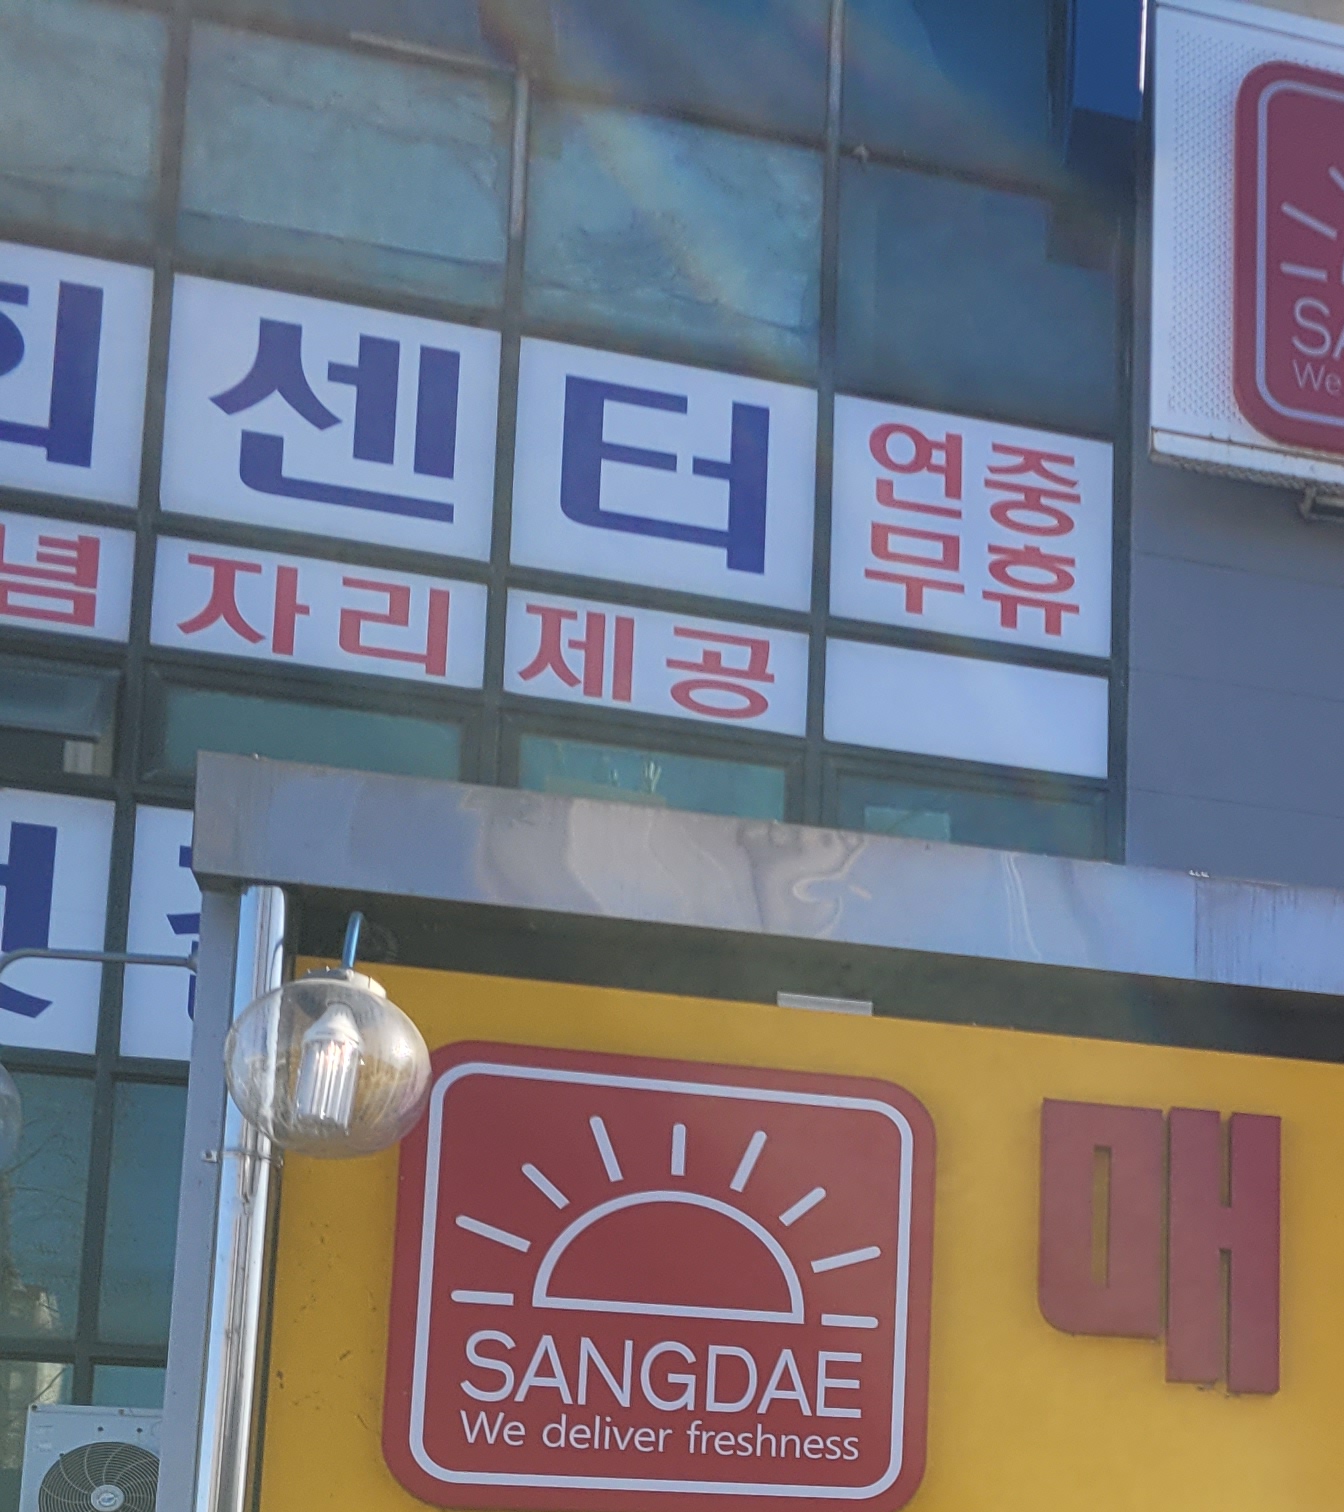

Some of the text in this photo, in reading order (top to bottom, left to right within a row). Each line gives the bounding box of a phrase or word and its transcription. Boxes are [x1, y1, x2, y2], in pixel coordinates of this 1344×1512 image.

[1292, 358, 1343, 394] We
[868, 422, 1082, 538] 연중
[863, 520, 1081, 637] 무휴
[178, 552, 449, 677] 자리
[518, 602, 776, 719] 제공
[459, 1329, 862, 1419] SANGDAE
[459, 1410, 860, 1462] We deliver freshness
